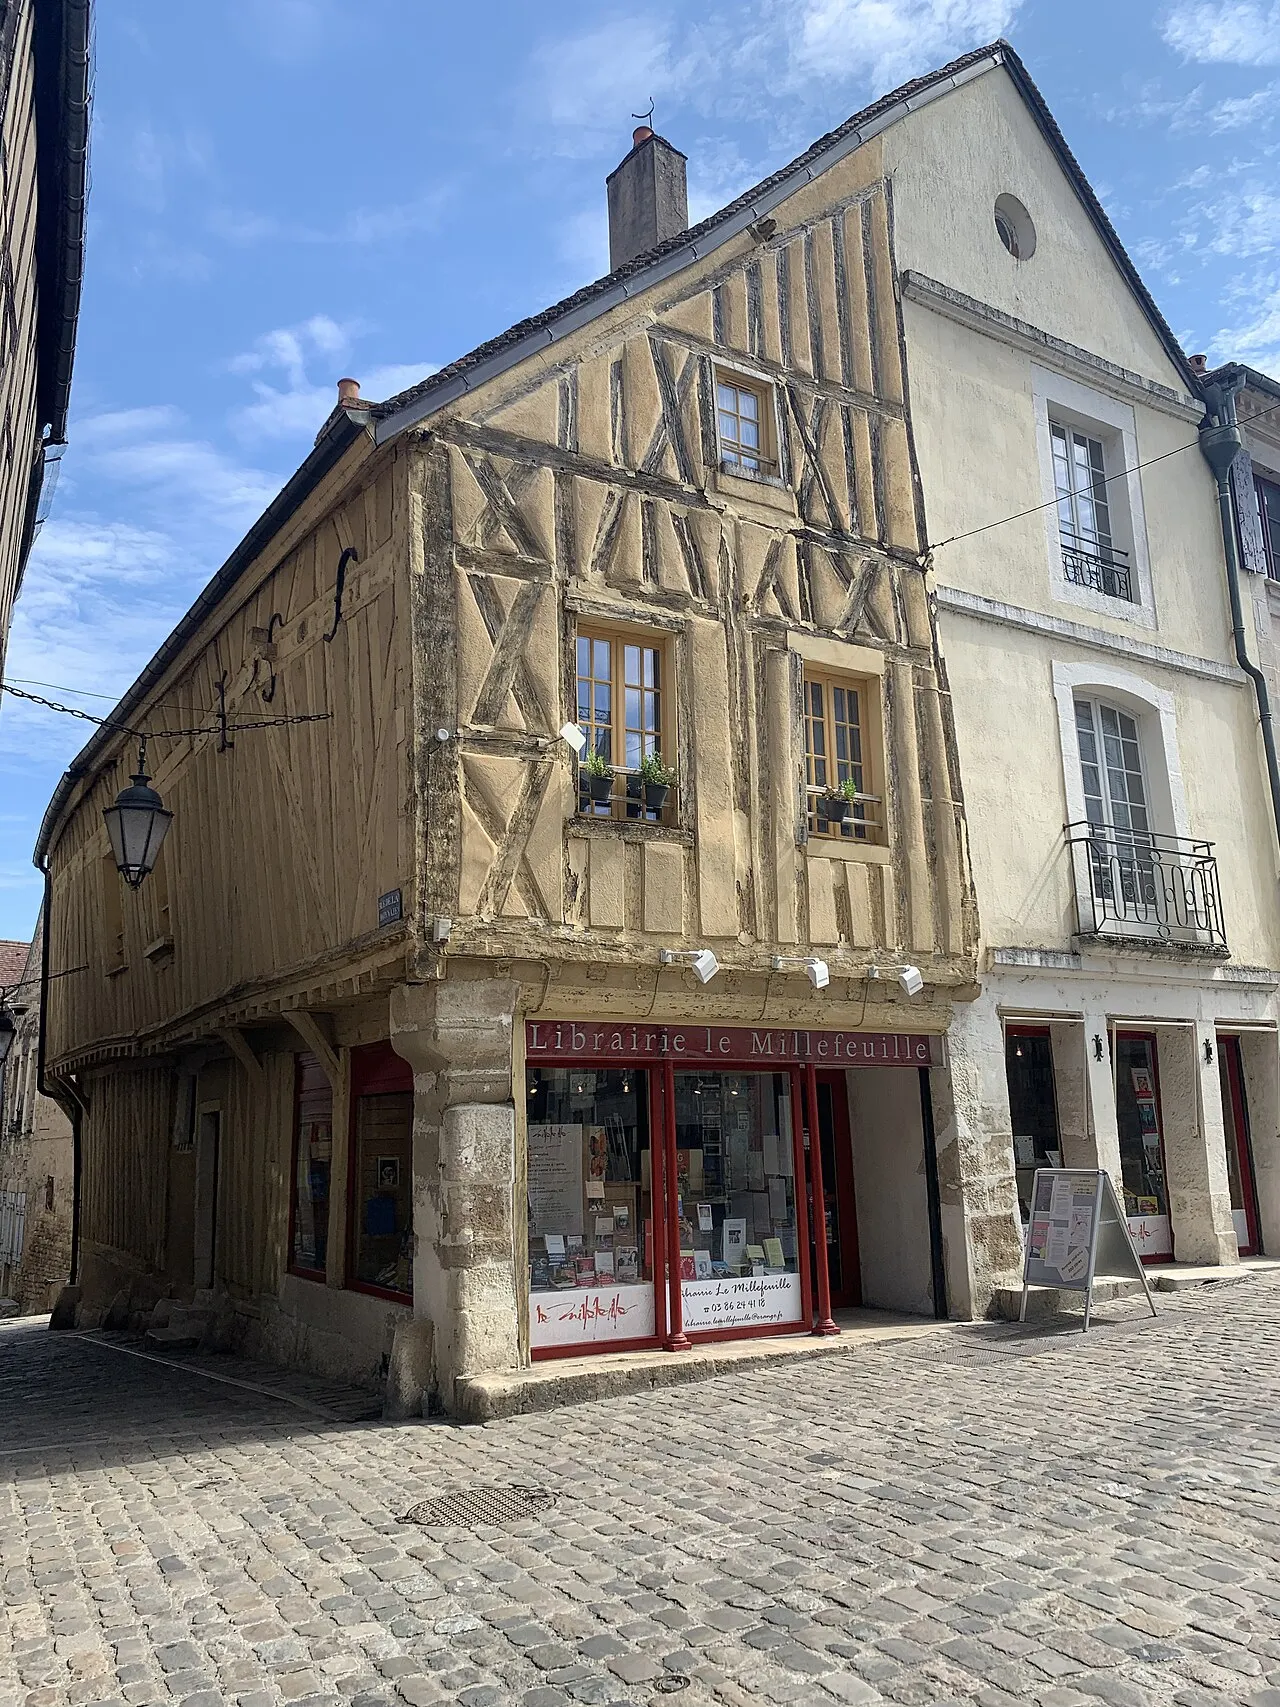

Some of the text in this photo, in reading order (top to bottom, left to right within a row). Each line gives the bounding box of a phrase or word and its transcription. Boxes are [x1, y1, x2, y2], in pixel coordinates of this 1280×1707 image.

[529, 1024, 927, 1059] Librairie le Millefeuille
[681, 1278, 792, 1298] ibrairie Le Millefeuille
[711, 1298, 765, 1312] 03 86 24 41 18
